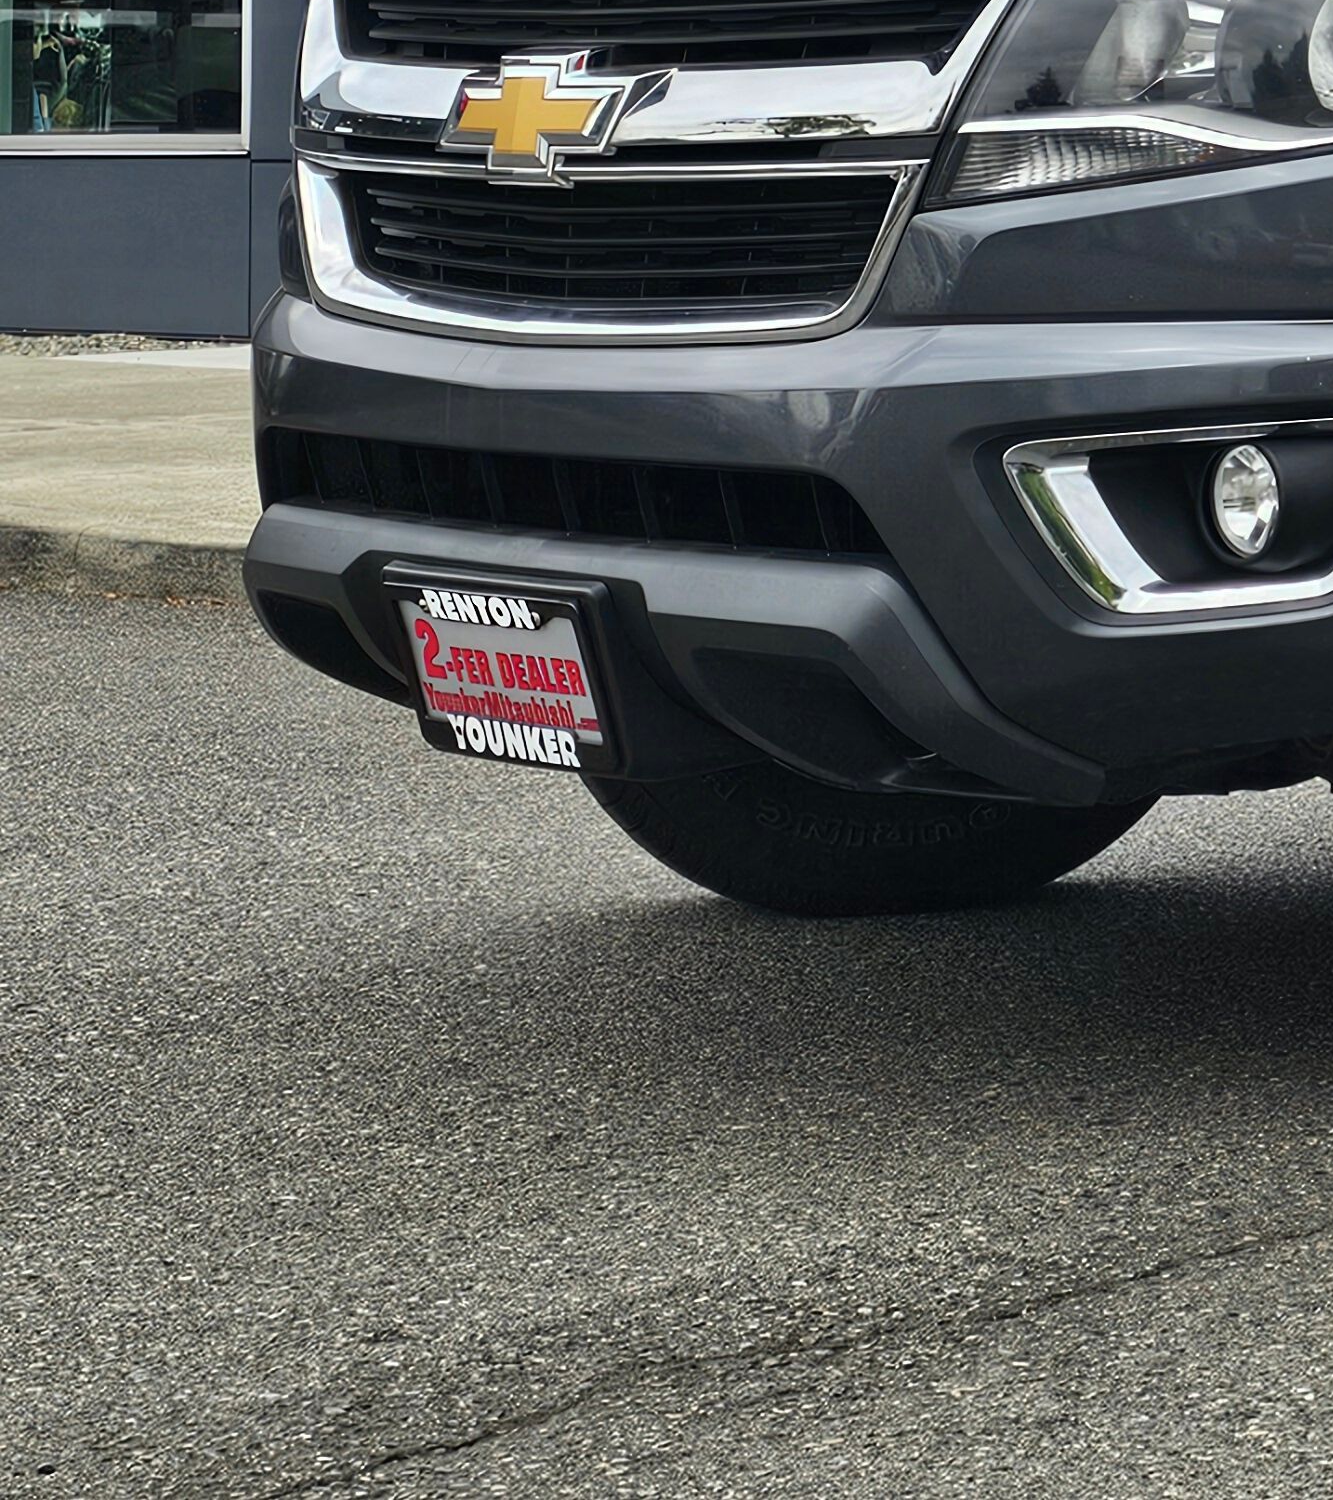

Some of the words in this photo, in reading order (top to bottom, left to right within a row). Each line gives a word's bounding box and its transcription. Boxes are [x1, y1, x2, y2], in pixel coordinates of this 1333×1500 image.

[421, 588, 537, 631] RENTON
[414, 618, 495, 687] 2-FER
[495, 651, 587, 697] DEALER
[446, 713, 582, 768] YOUNKER
